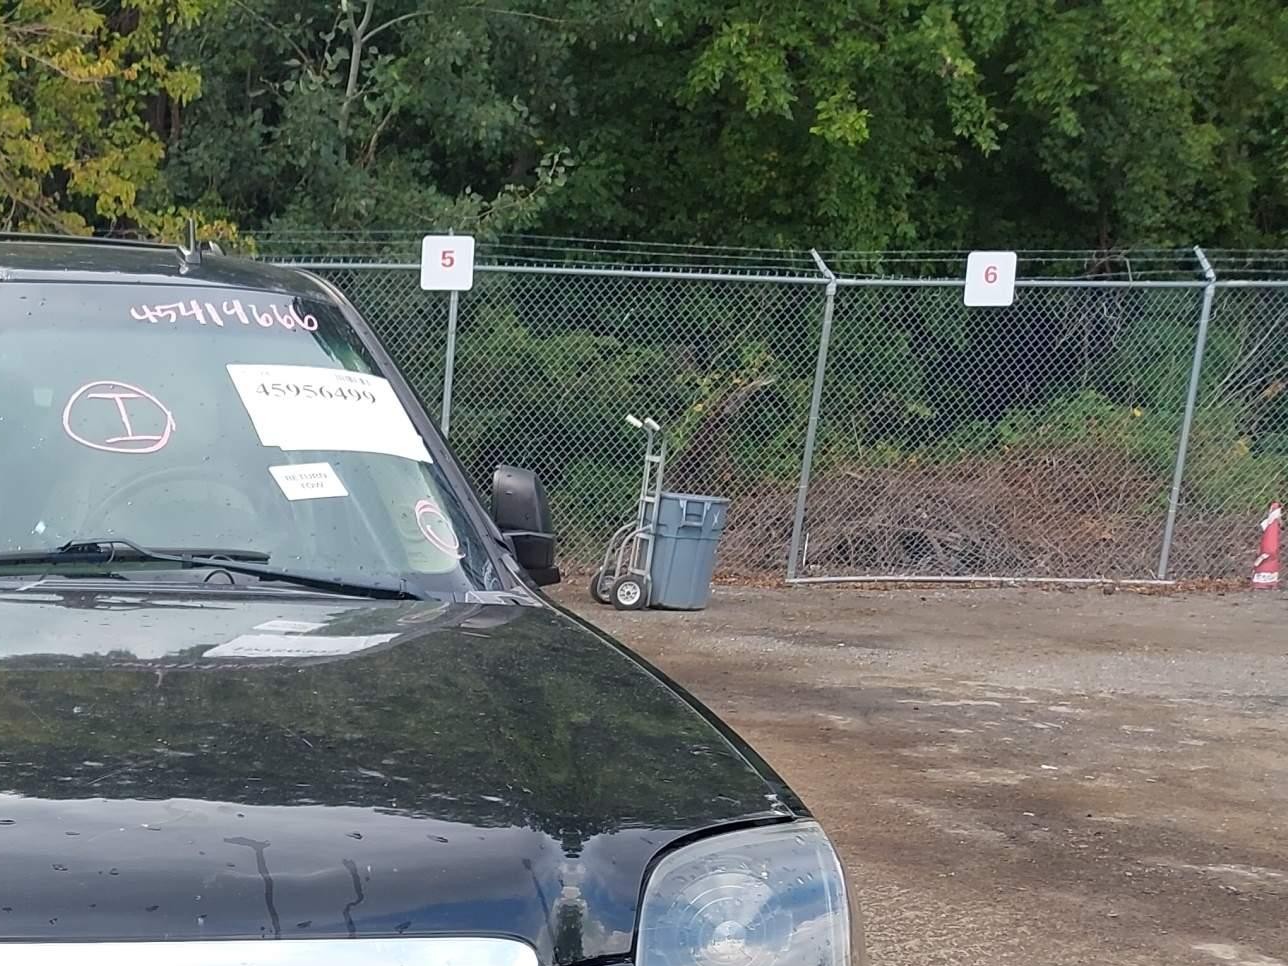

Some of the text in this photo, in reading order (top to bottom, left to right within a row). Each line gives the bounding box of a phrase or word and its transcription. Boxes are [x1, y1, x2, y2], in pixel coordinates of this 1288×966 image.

[440, 249, 456, 268] 5
[983, 264, 999, 284] 6
[255, 382, 377, 404] 45956499
